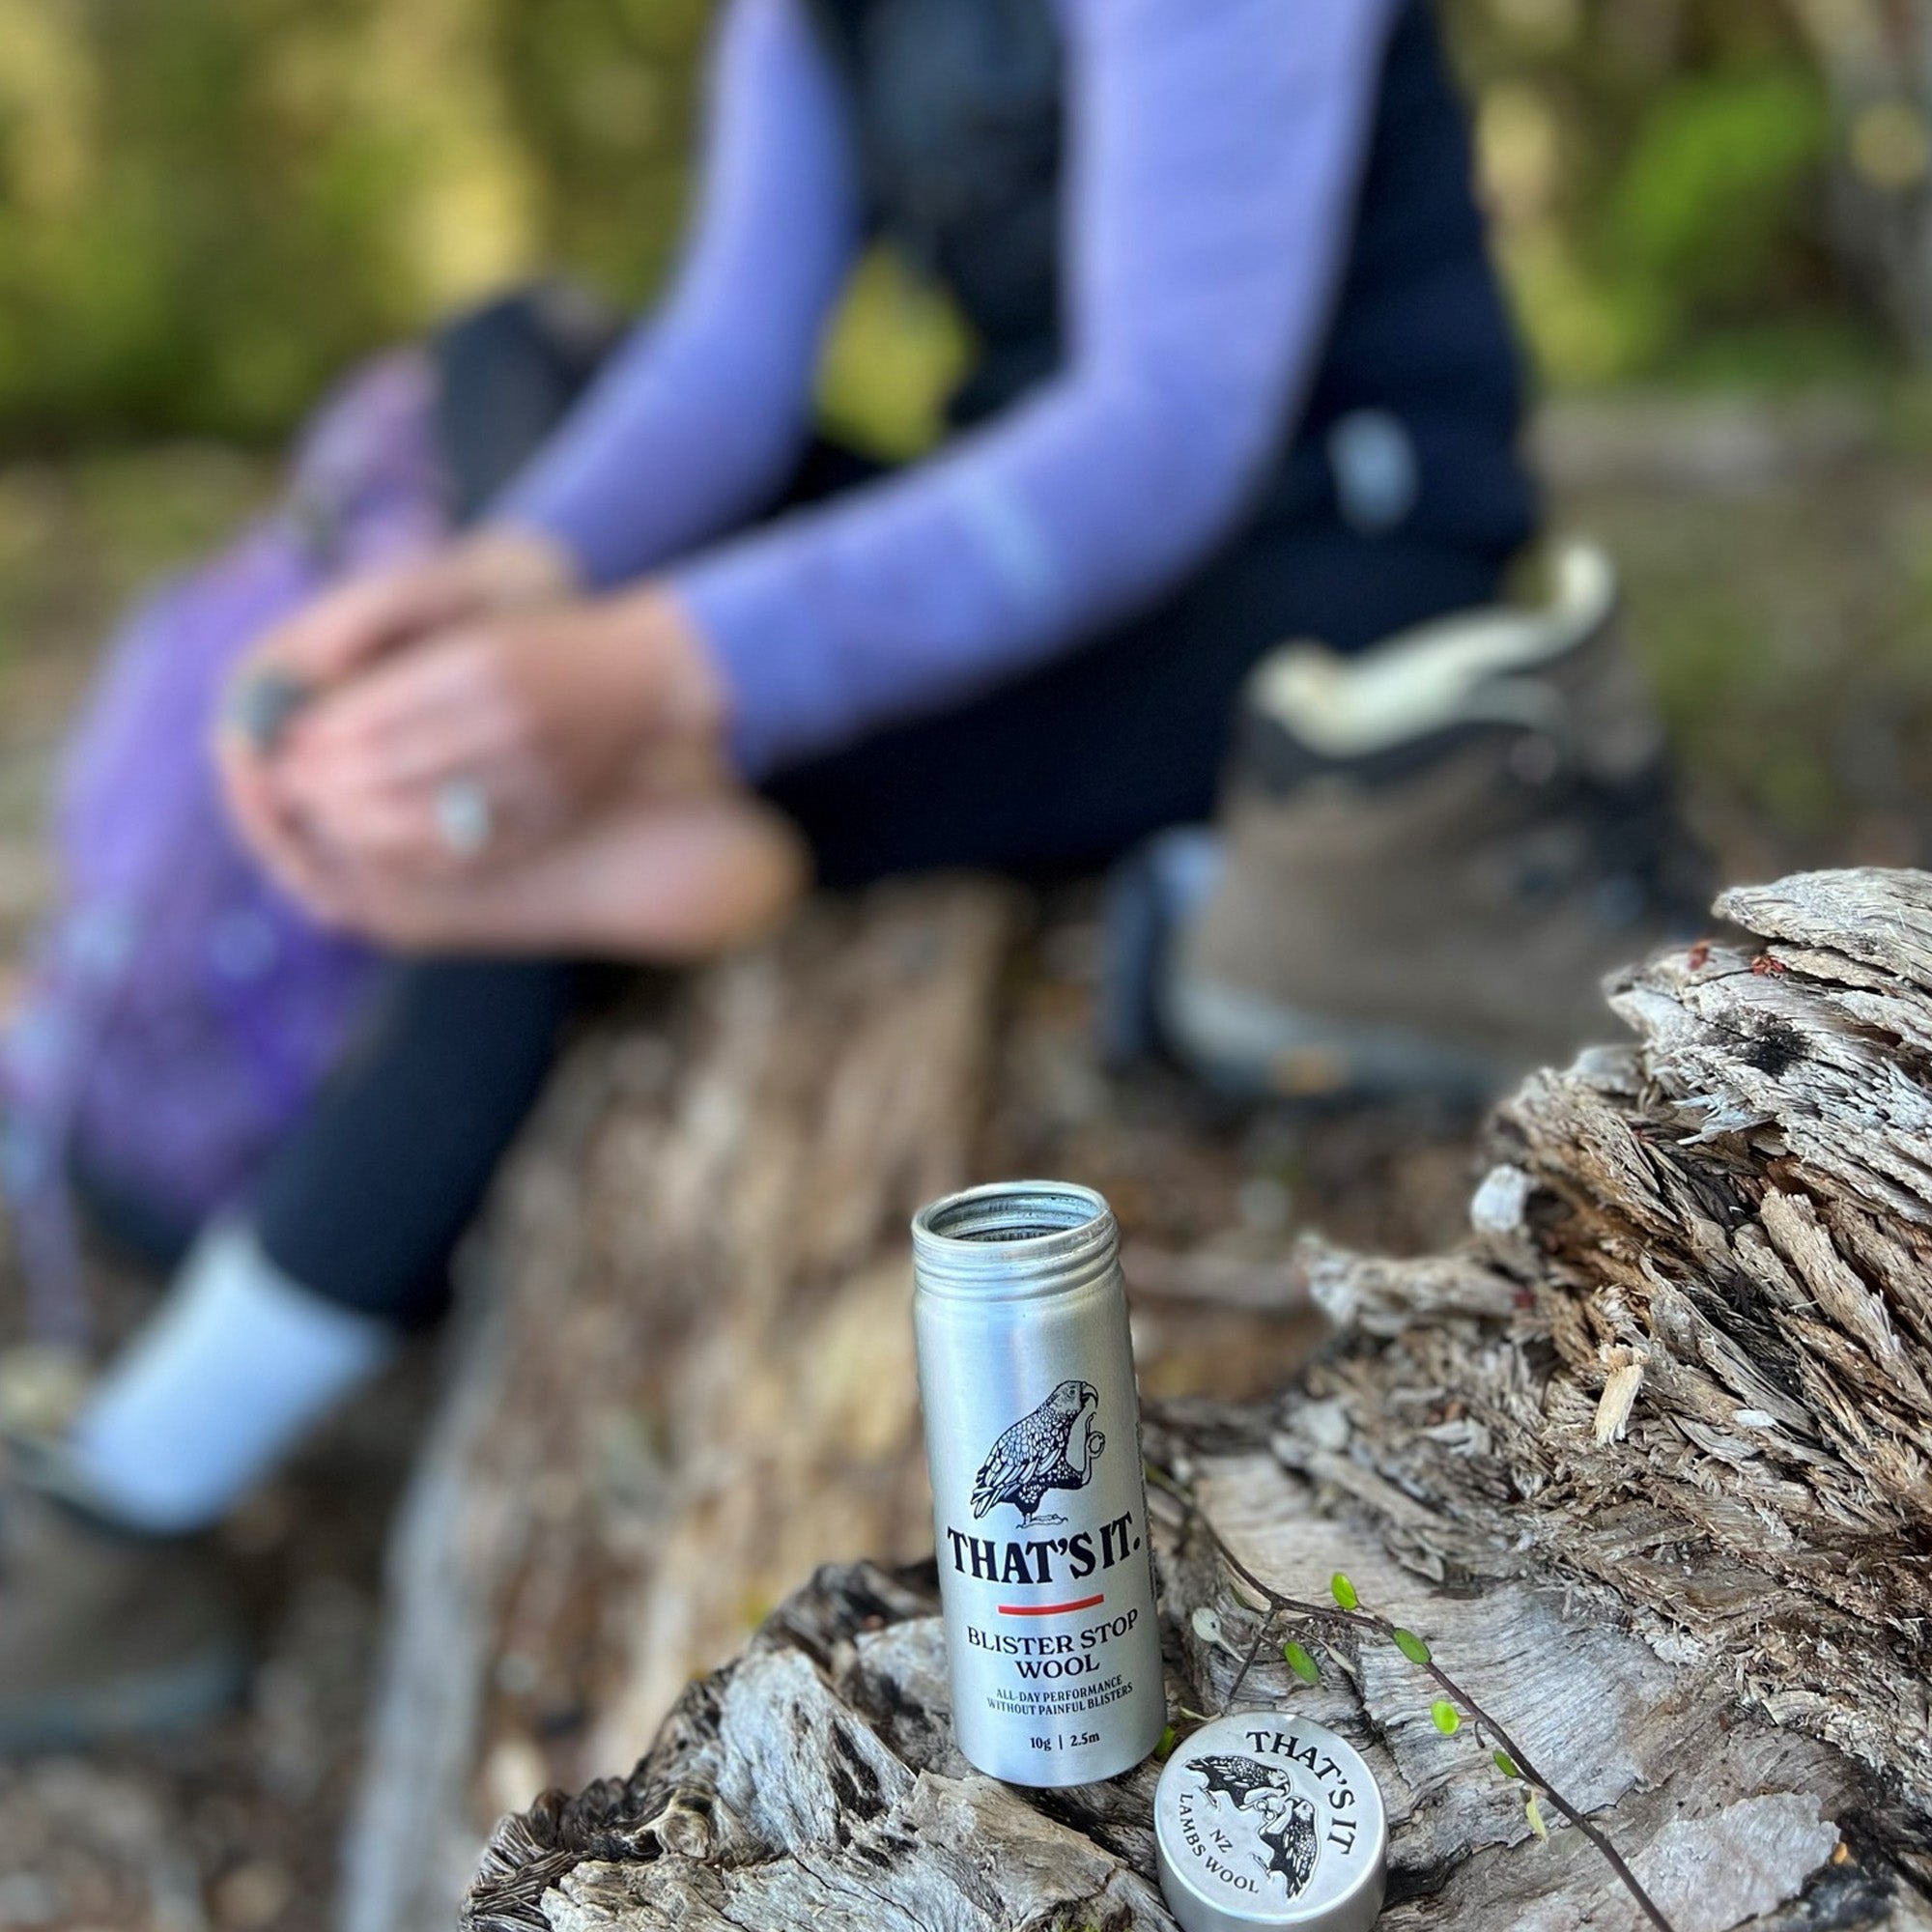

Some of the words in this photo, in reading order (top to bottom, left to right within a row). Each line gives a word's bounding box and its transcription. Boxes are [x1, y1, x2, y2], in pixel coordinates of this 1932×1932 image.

[947, 1525, 1096, 1584] THAT'S
[1098, 1511, 1141, 1569] IT.
[967, 1625, 1074, 1656] BLISTER
[1079, 1607, 1138, 1649] STOP
[1014, 1654, 1100, 1679] WOOL
[986, 1696, 1037, 1715] WITHOUT
[1038, 1701, 1086, 1716] PAINFUL
[1087, 1681, 1133, 1710] BLISTERS
[996, 1689, 1040, 1703] ALL-DAY
[1042, 1673, 1122, 1703] PERFORMANCE
[1030, 1736, 1052, 1751] 10g
[1070, 1731, 1100, 1747] 2.5m
[1246, 1731, 1355, 1810] THAT'S
[1326, 1817, 1356, 1856] IT
[1179, 1792, 1207, 1858] LAMBS
[1205, 1856, 1259, 1894] WOOL
[1209, 1829, 1234, 1853] NZ
